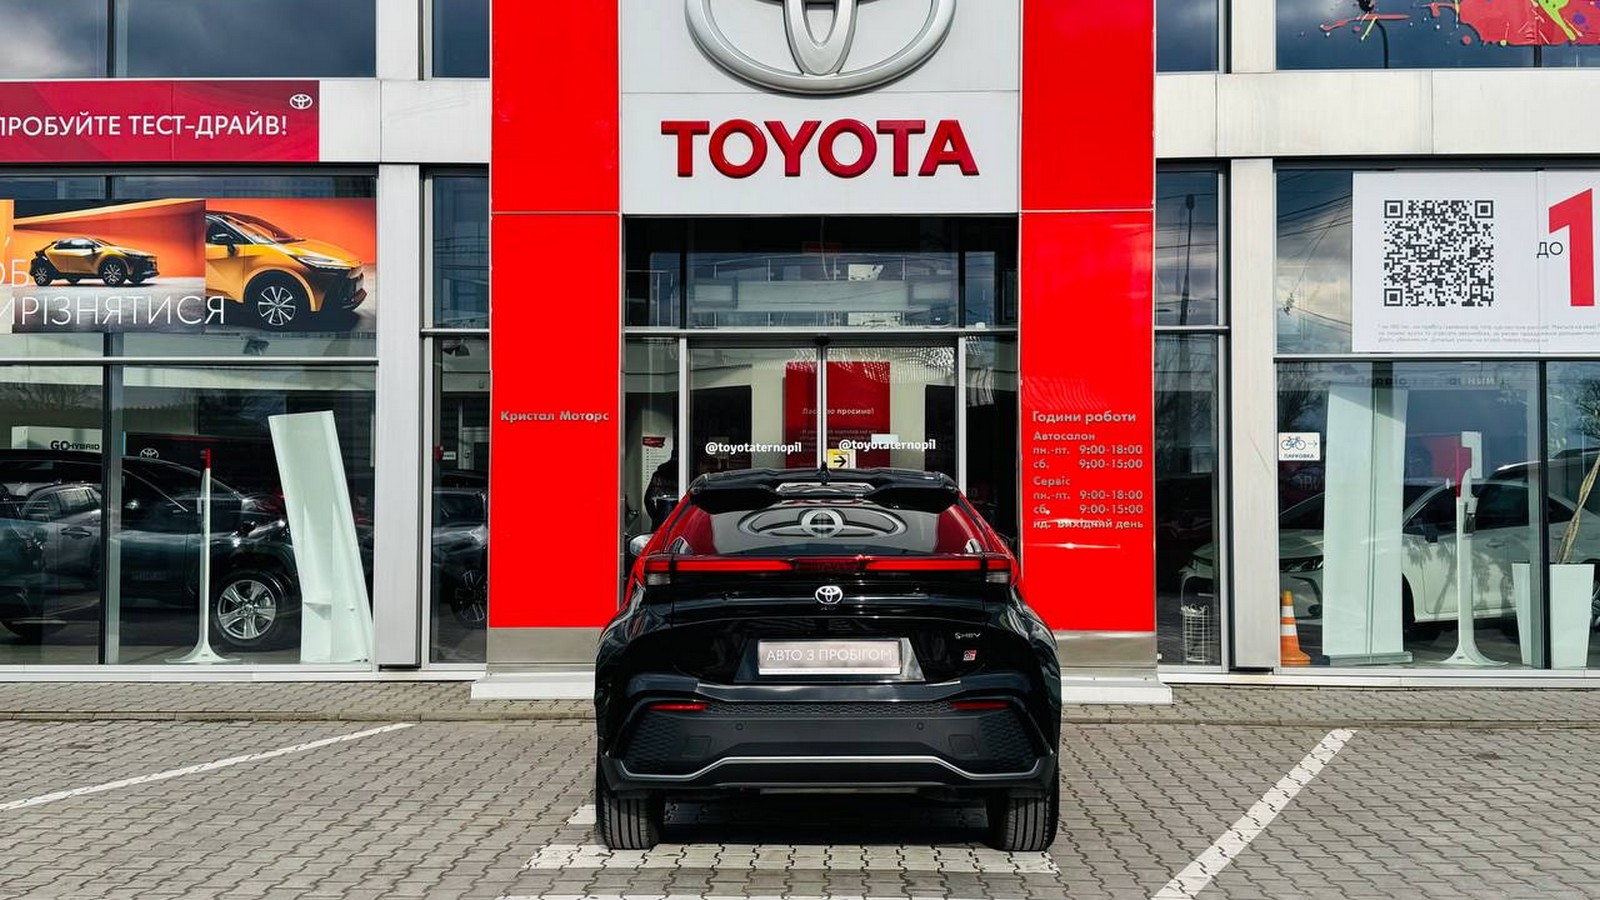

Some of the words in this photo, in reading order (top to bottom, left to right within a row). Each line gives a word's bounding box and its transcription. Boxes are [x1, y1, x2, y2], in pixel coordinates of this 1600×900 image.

[128, 111, 288, 139] ТЕСТ-ДРАЙВ!
[661, 118, 980, 179] TOYOTA
[0, 259, 29, 288] Б
[500, 410, 555, 423] Кристал
[559, 410, 609, 423] Моторс
[1032, 410, 1081, 423] Години
[1085, 410, 1136, 424] роботи
[1033, 431, 1095, 441] Автосалон
[705, 441, 802, 455] @toyotaternopil
[838, 439, 936, 452] @toyotaternopil
[1033, 475, 1071, 487] Сервіс
[1115, 520, 1144, 530] день
[766, 649, 802, 661] АВТО
[818, 649, 893, 661] ПРОБІГОМ
